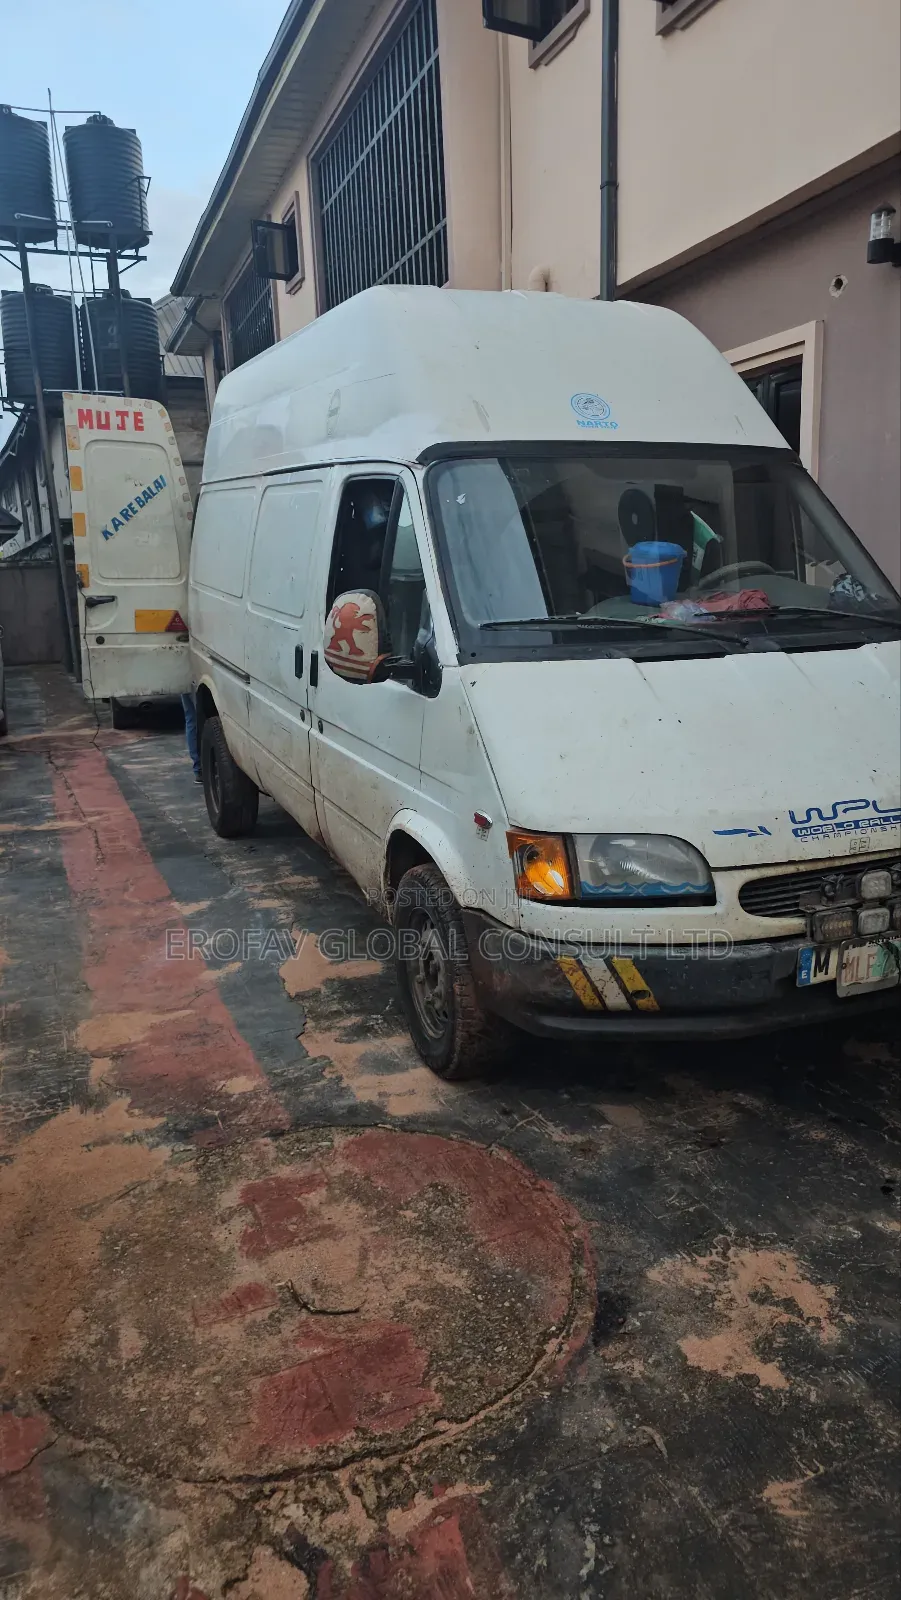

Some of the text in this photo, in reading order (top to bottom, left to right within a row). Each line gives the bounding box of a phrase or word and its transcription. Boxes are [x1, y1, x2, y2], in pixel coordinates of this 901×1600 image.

[78, 408, 144, 431] MUJE
[859, 816, 901, 828] RALL
[801, 825, 898, 843] CHAMPIONSH
